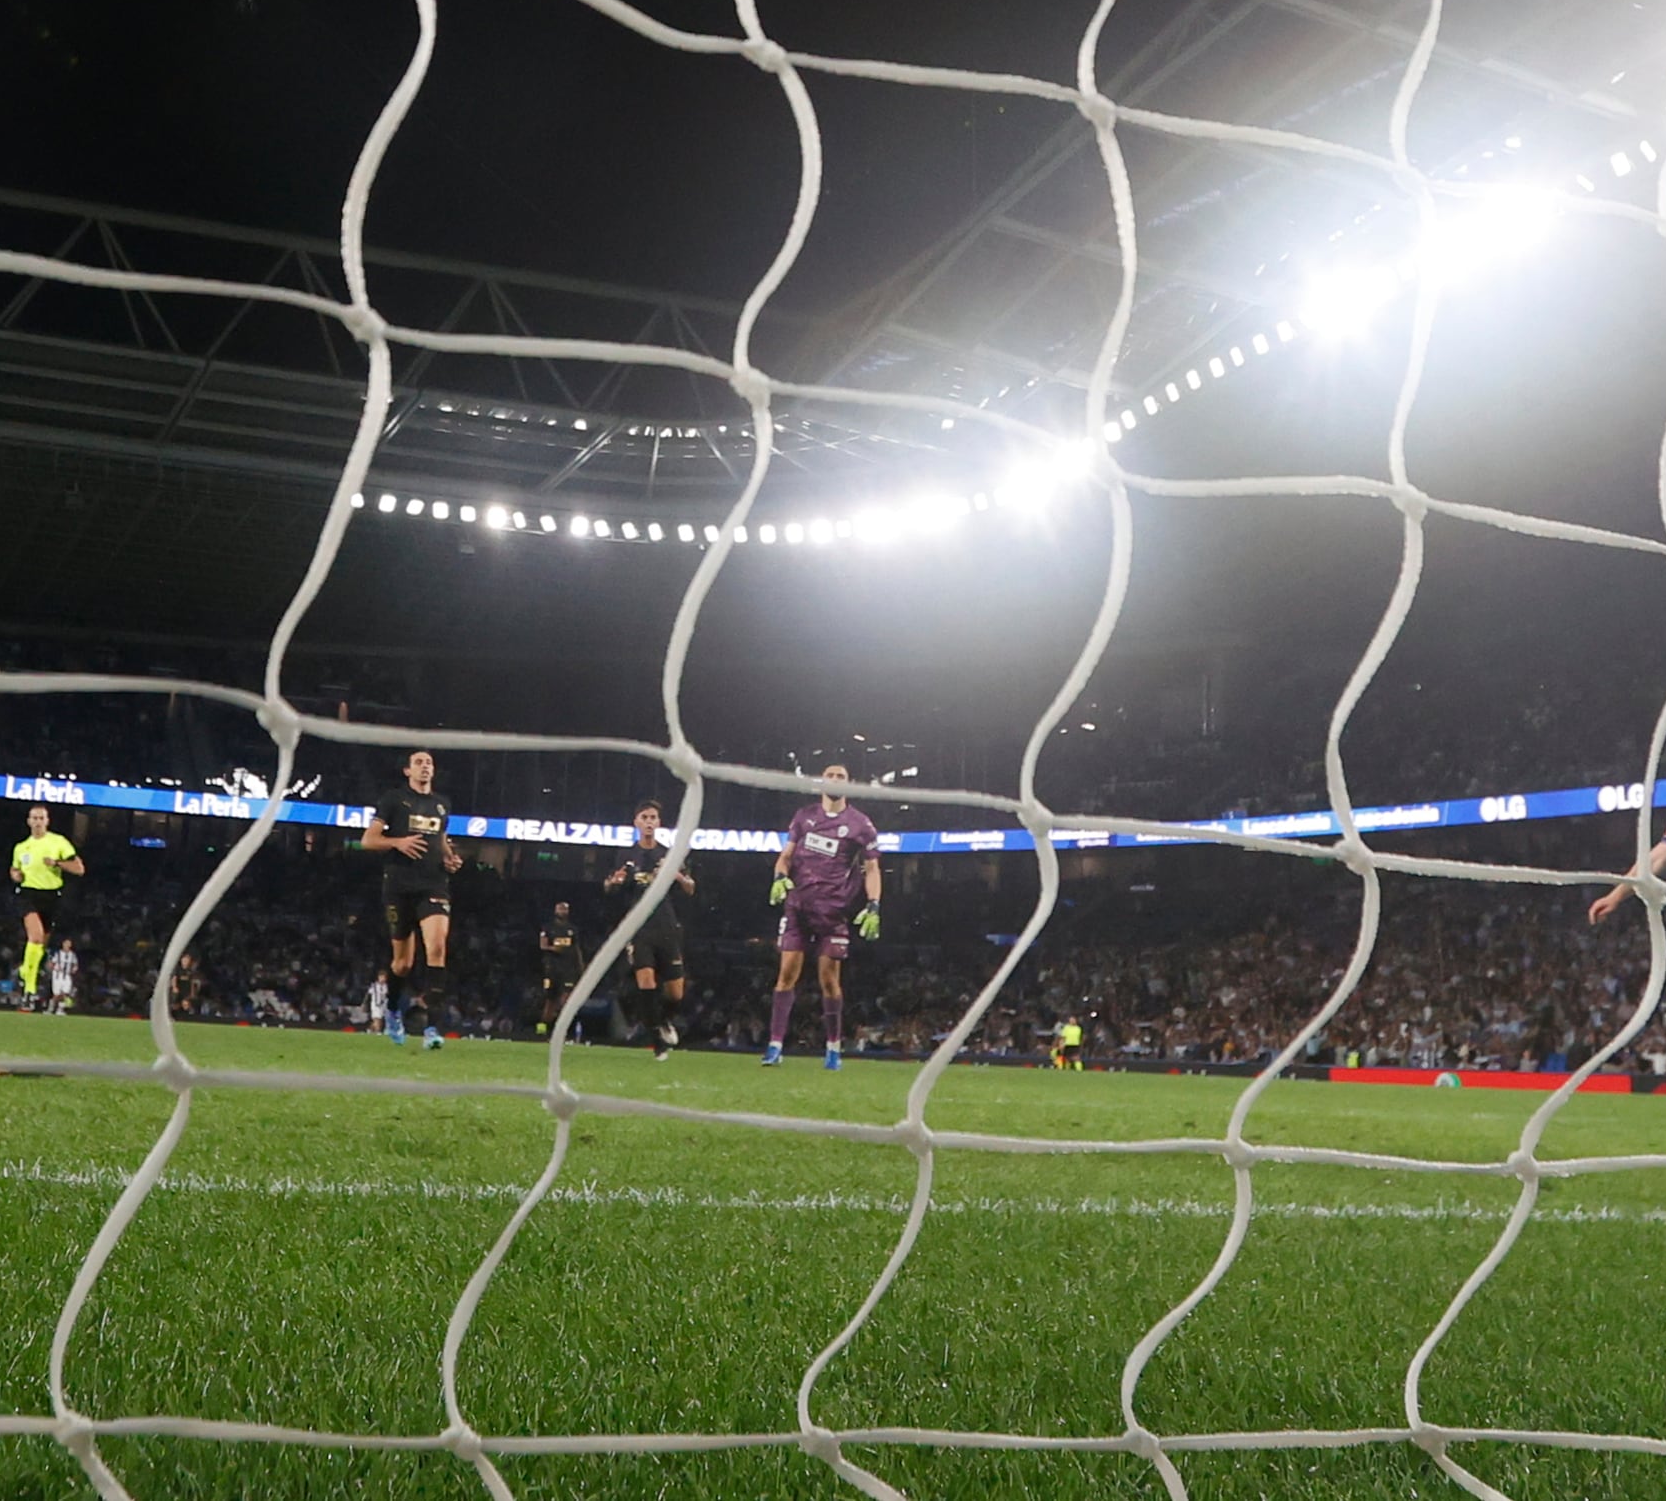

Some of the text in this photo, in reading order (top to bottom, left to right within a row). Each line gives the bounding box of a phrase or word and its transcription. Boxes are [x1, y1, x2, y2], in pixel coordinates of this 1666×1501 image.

[1498, 795, 1527, 820] LG
[1615, 783, 1645, 810] LG
[506, 819, 634, 847] REALZALE
